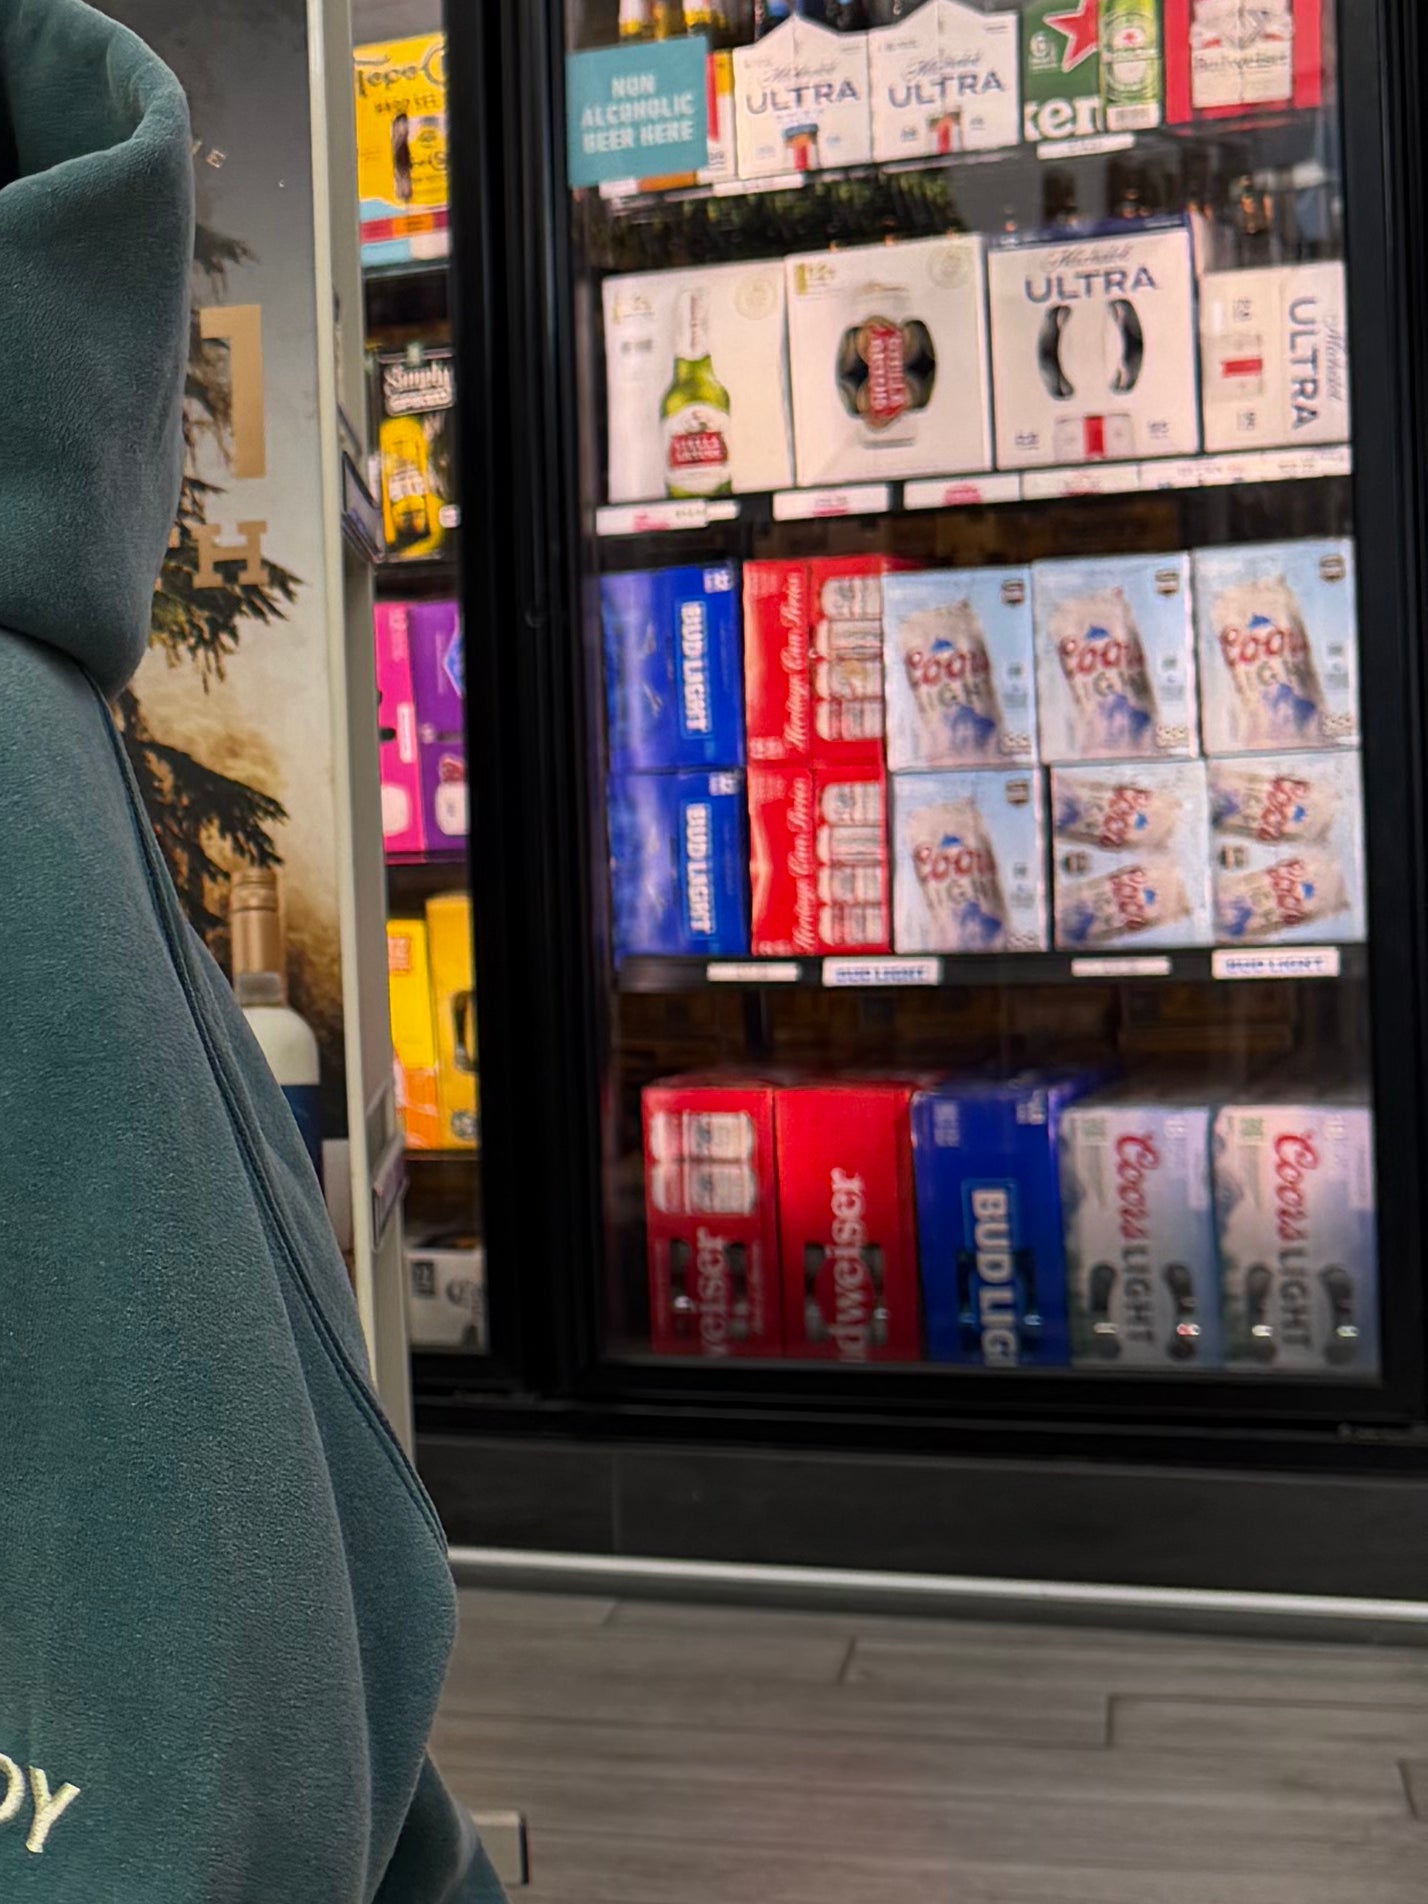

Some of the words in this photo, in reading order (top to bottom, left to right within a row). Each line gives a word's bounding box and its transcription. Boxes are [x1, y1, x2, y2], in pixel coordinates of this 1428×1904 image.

[580, 94, 696, 123] ALCOHOLIC
[612, 74, 655, 99] NON
[745, 81, 861, 116] ULTRA
[887, 72, 1006, 109] ULTRA
[584, 128, 636, 154] BEER
[640, 121, 694, 149] HERE
[1023, 265, 1158, 304] ULTRA
[1287, 297, 1321, 431] ULTRA
[1114, 1134, 1162, 1243] Coors
[1275, 1132, 1321, 1244] Coors
[973, 1187, 1009, 1280] BUD
[1120, 1245, 1157, 1346] LIGHT
[1277, 1246, 1311, 1351] LIGHT
